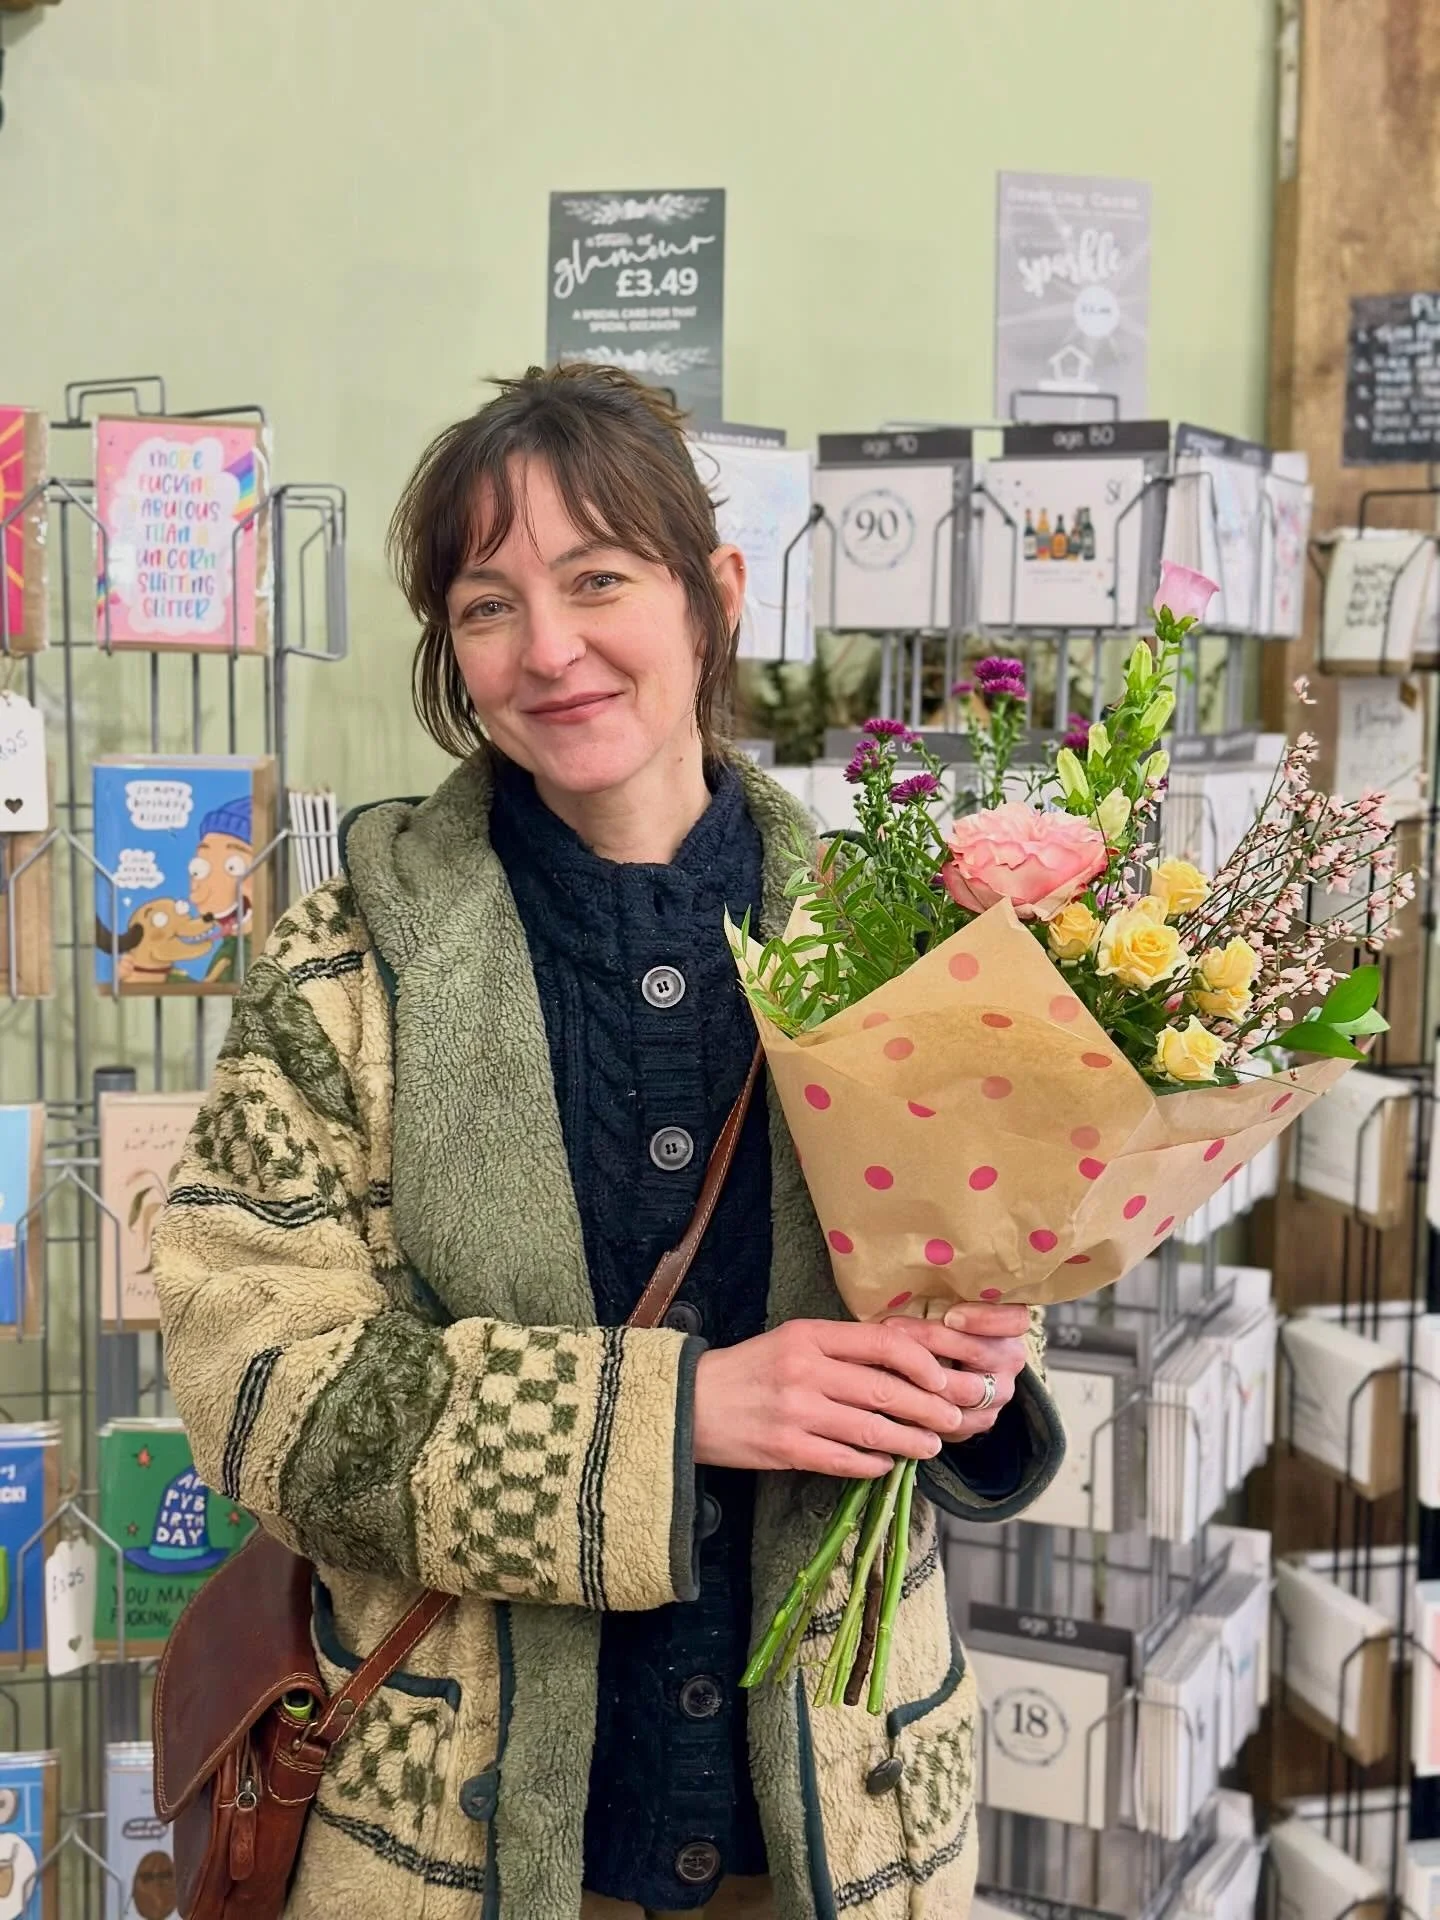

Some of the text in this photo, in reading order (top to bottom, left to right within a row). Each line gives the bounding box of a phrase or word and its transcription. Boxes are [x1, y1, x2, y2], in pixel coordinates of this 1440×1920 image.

[553, 237, 716, 299] glamour
[615, 267, 699, 298] £3.49
[1052, 424, 1115, 452] age 80
[855, 508, 899, 541] 90
[155, 1526, 204, 1547] DAY
[1012, 1702, 1050, 1740] 18
